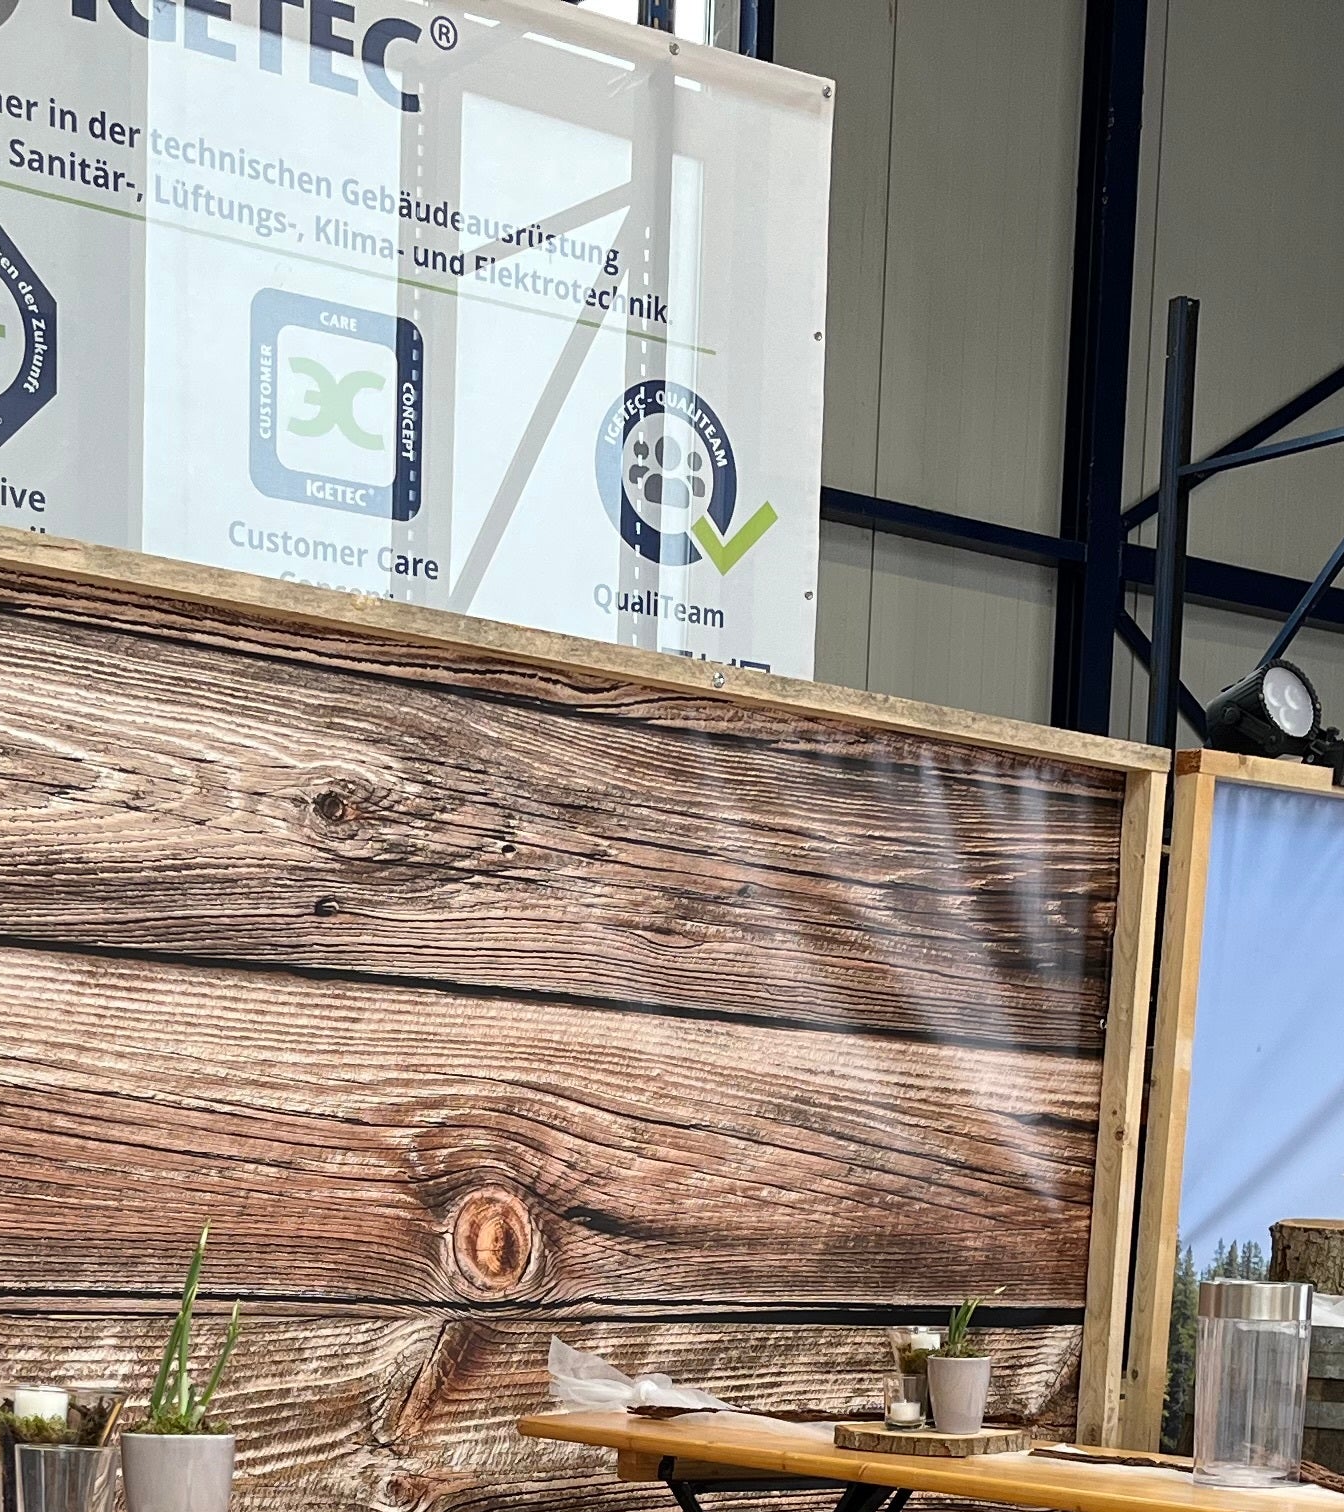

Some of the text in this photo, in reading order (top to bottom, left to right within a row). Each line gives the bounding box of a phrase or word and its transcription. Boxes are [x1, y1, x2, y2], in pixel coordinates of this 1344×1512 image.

[72, 0, 458, 112] ETEC®
[9, 138, 143, 202] Sanitär-,
[155, 175, 304, 243] Lüftungs-,
[315, 215, 404, 260] Klima-
[413, 245, 465, 277] und
[49, 98, 77, 133] in
[88, 111, 141, 148] der
[150, 128, 331, 198] technischen
[342, 178, 619, 276] Gebäudeausrüstung
[18, 281, 39, 314] der
[319, 311, 358, 332] CARE
[22, 318, 48, 394] Zukunft
[259, 344, 273, 439] CUSTOMER
[401, 381, 415, 462] CONCEPT
[228, 520, 439, 580] Customer Care
[593, 583, 724, 628] QualiTeam
